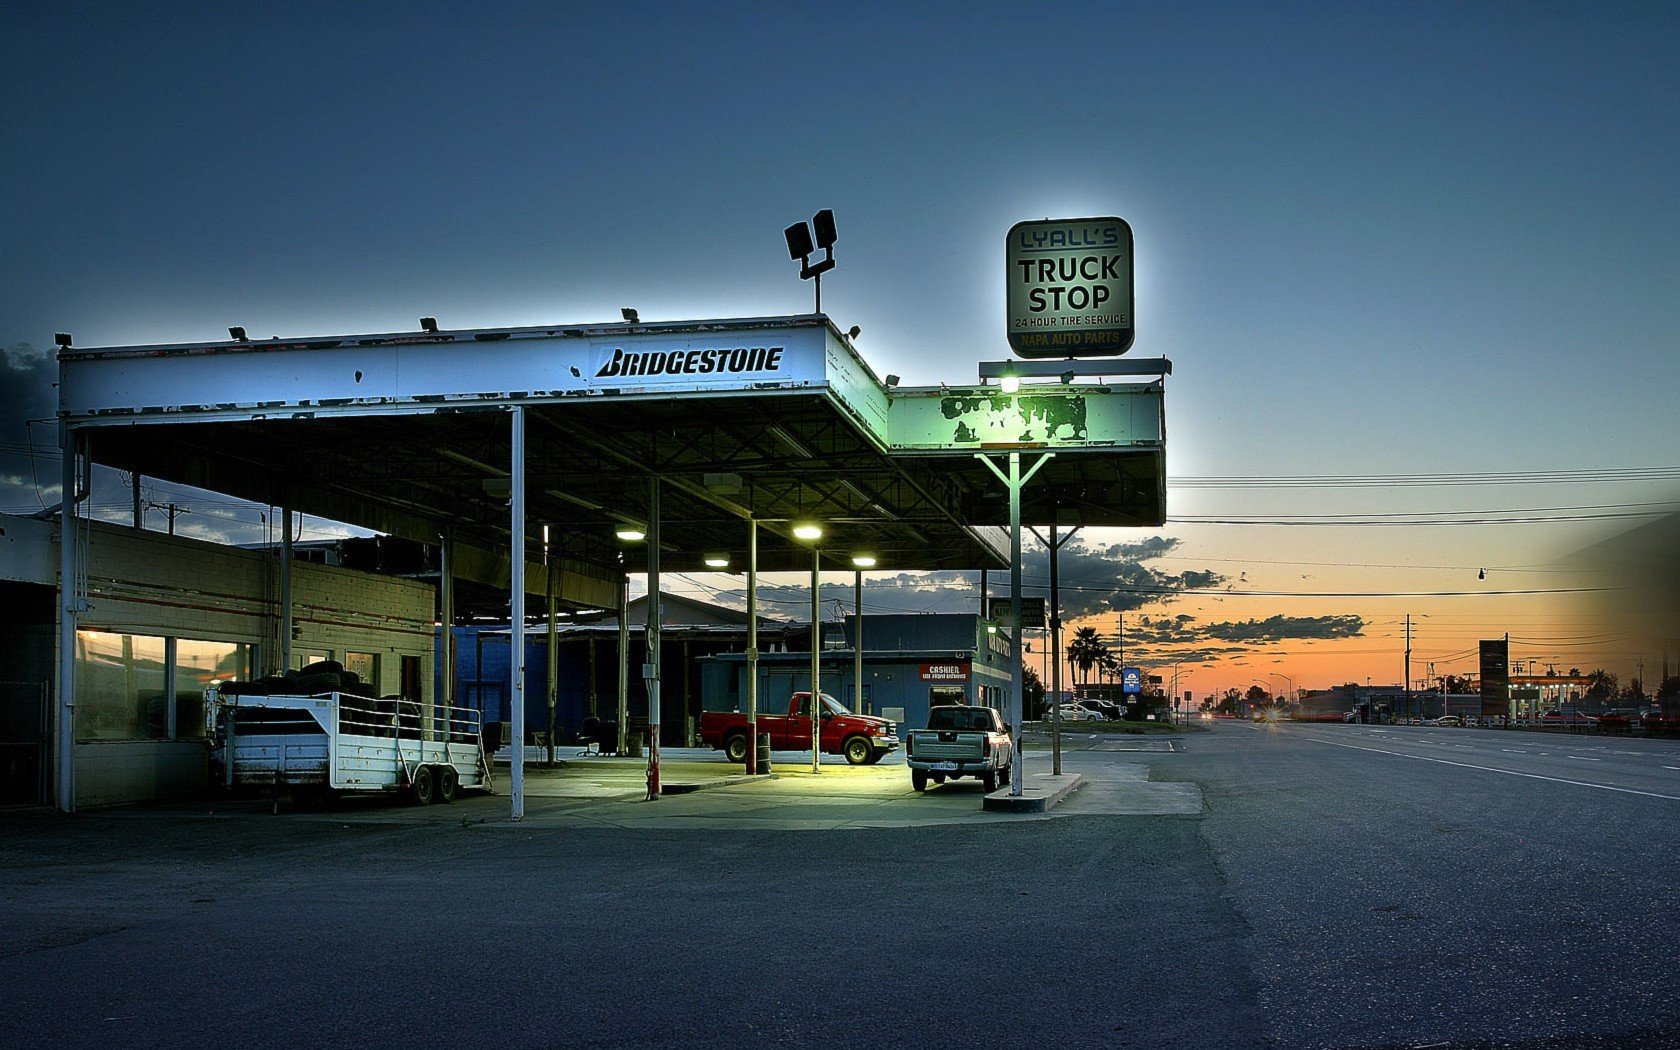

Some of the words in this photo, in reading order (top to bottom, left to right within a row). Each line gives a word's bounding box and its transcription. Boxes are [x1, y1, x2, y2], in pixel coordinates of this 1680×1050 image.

[1020, 227, 1119, 248] LYALL'S
[1017, 255, 1122, 284] TRUCK
[1028, 285, 1110, 313] STOP
[1015, 318, 1028, 328] 24
[1030, 317, 1057, 327] HOUR
[1060, 316, 1081, 326] TIRE
[1084, 314, 1126, 325] SERVICE
[1021, 333, 1049, 346] NAPA
[1051, 332, 1081, 345] AUTO
[1084, 331, 1120, 344] PARTS
[595, 347, 785, 378] BRIDGESTONE
[929, 665, 960, 674] CASHIER
